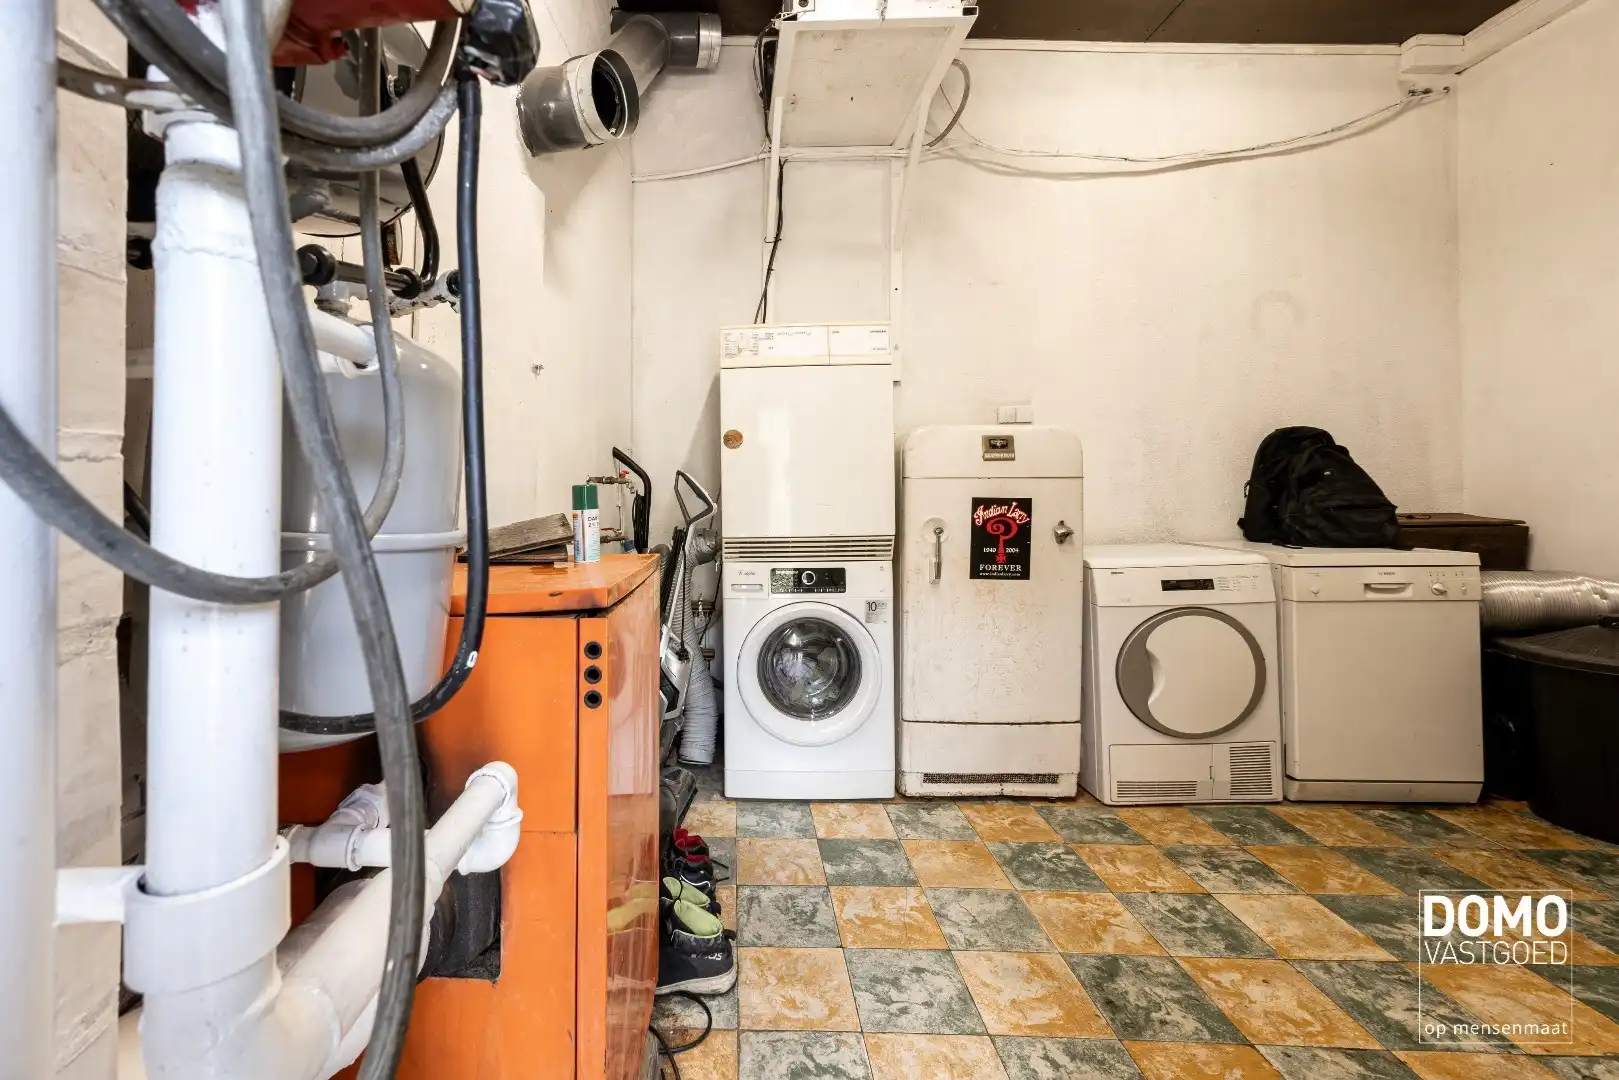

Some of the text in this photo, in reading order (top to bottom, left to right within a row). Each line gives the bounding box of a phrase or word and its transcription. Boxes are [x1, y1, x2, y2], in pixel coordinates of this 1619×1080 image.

[974, 505, 1008, 526] Indian
[979, 563, 1022, 572] FOREVER
[866, 601, 878, 612] 10
